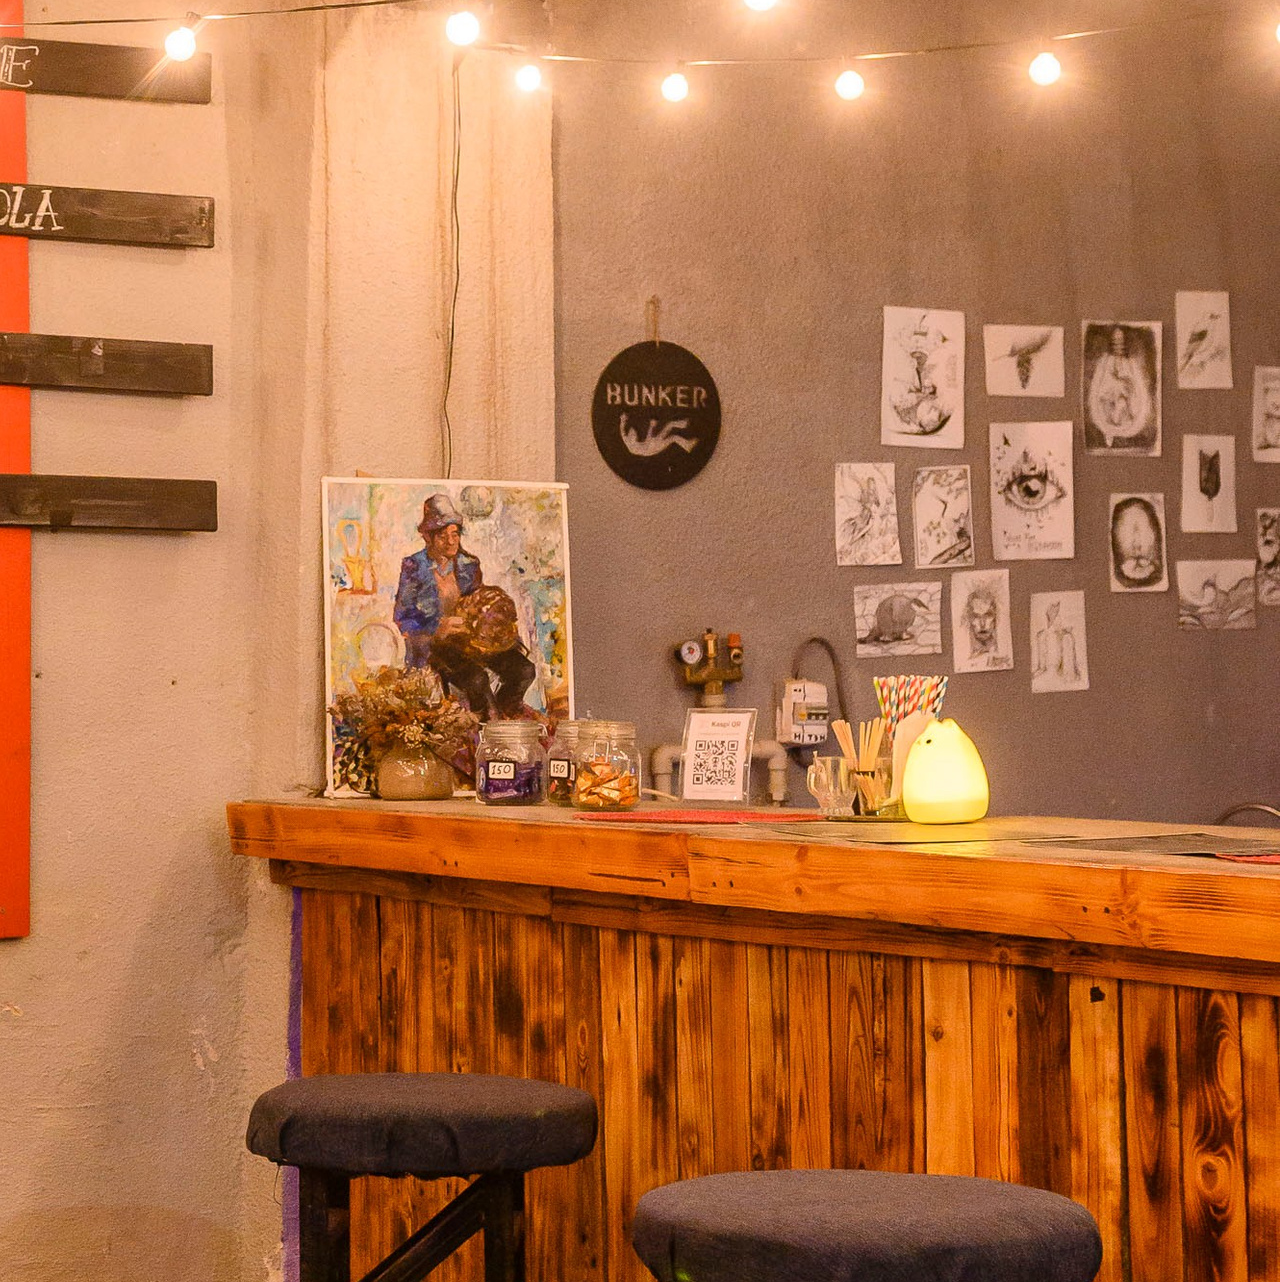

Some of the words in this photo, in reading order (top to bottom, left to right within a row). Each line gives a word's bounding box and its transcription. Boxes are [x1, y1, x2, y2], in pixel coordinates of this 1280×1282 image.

[606, 382, 708, 409] BUNKER
[491, 764, 511, 775] 150
[552, 763, 566, 774] 150
